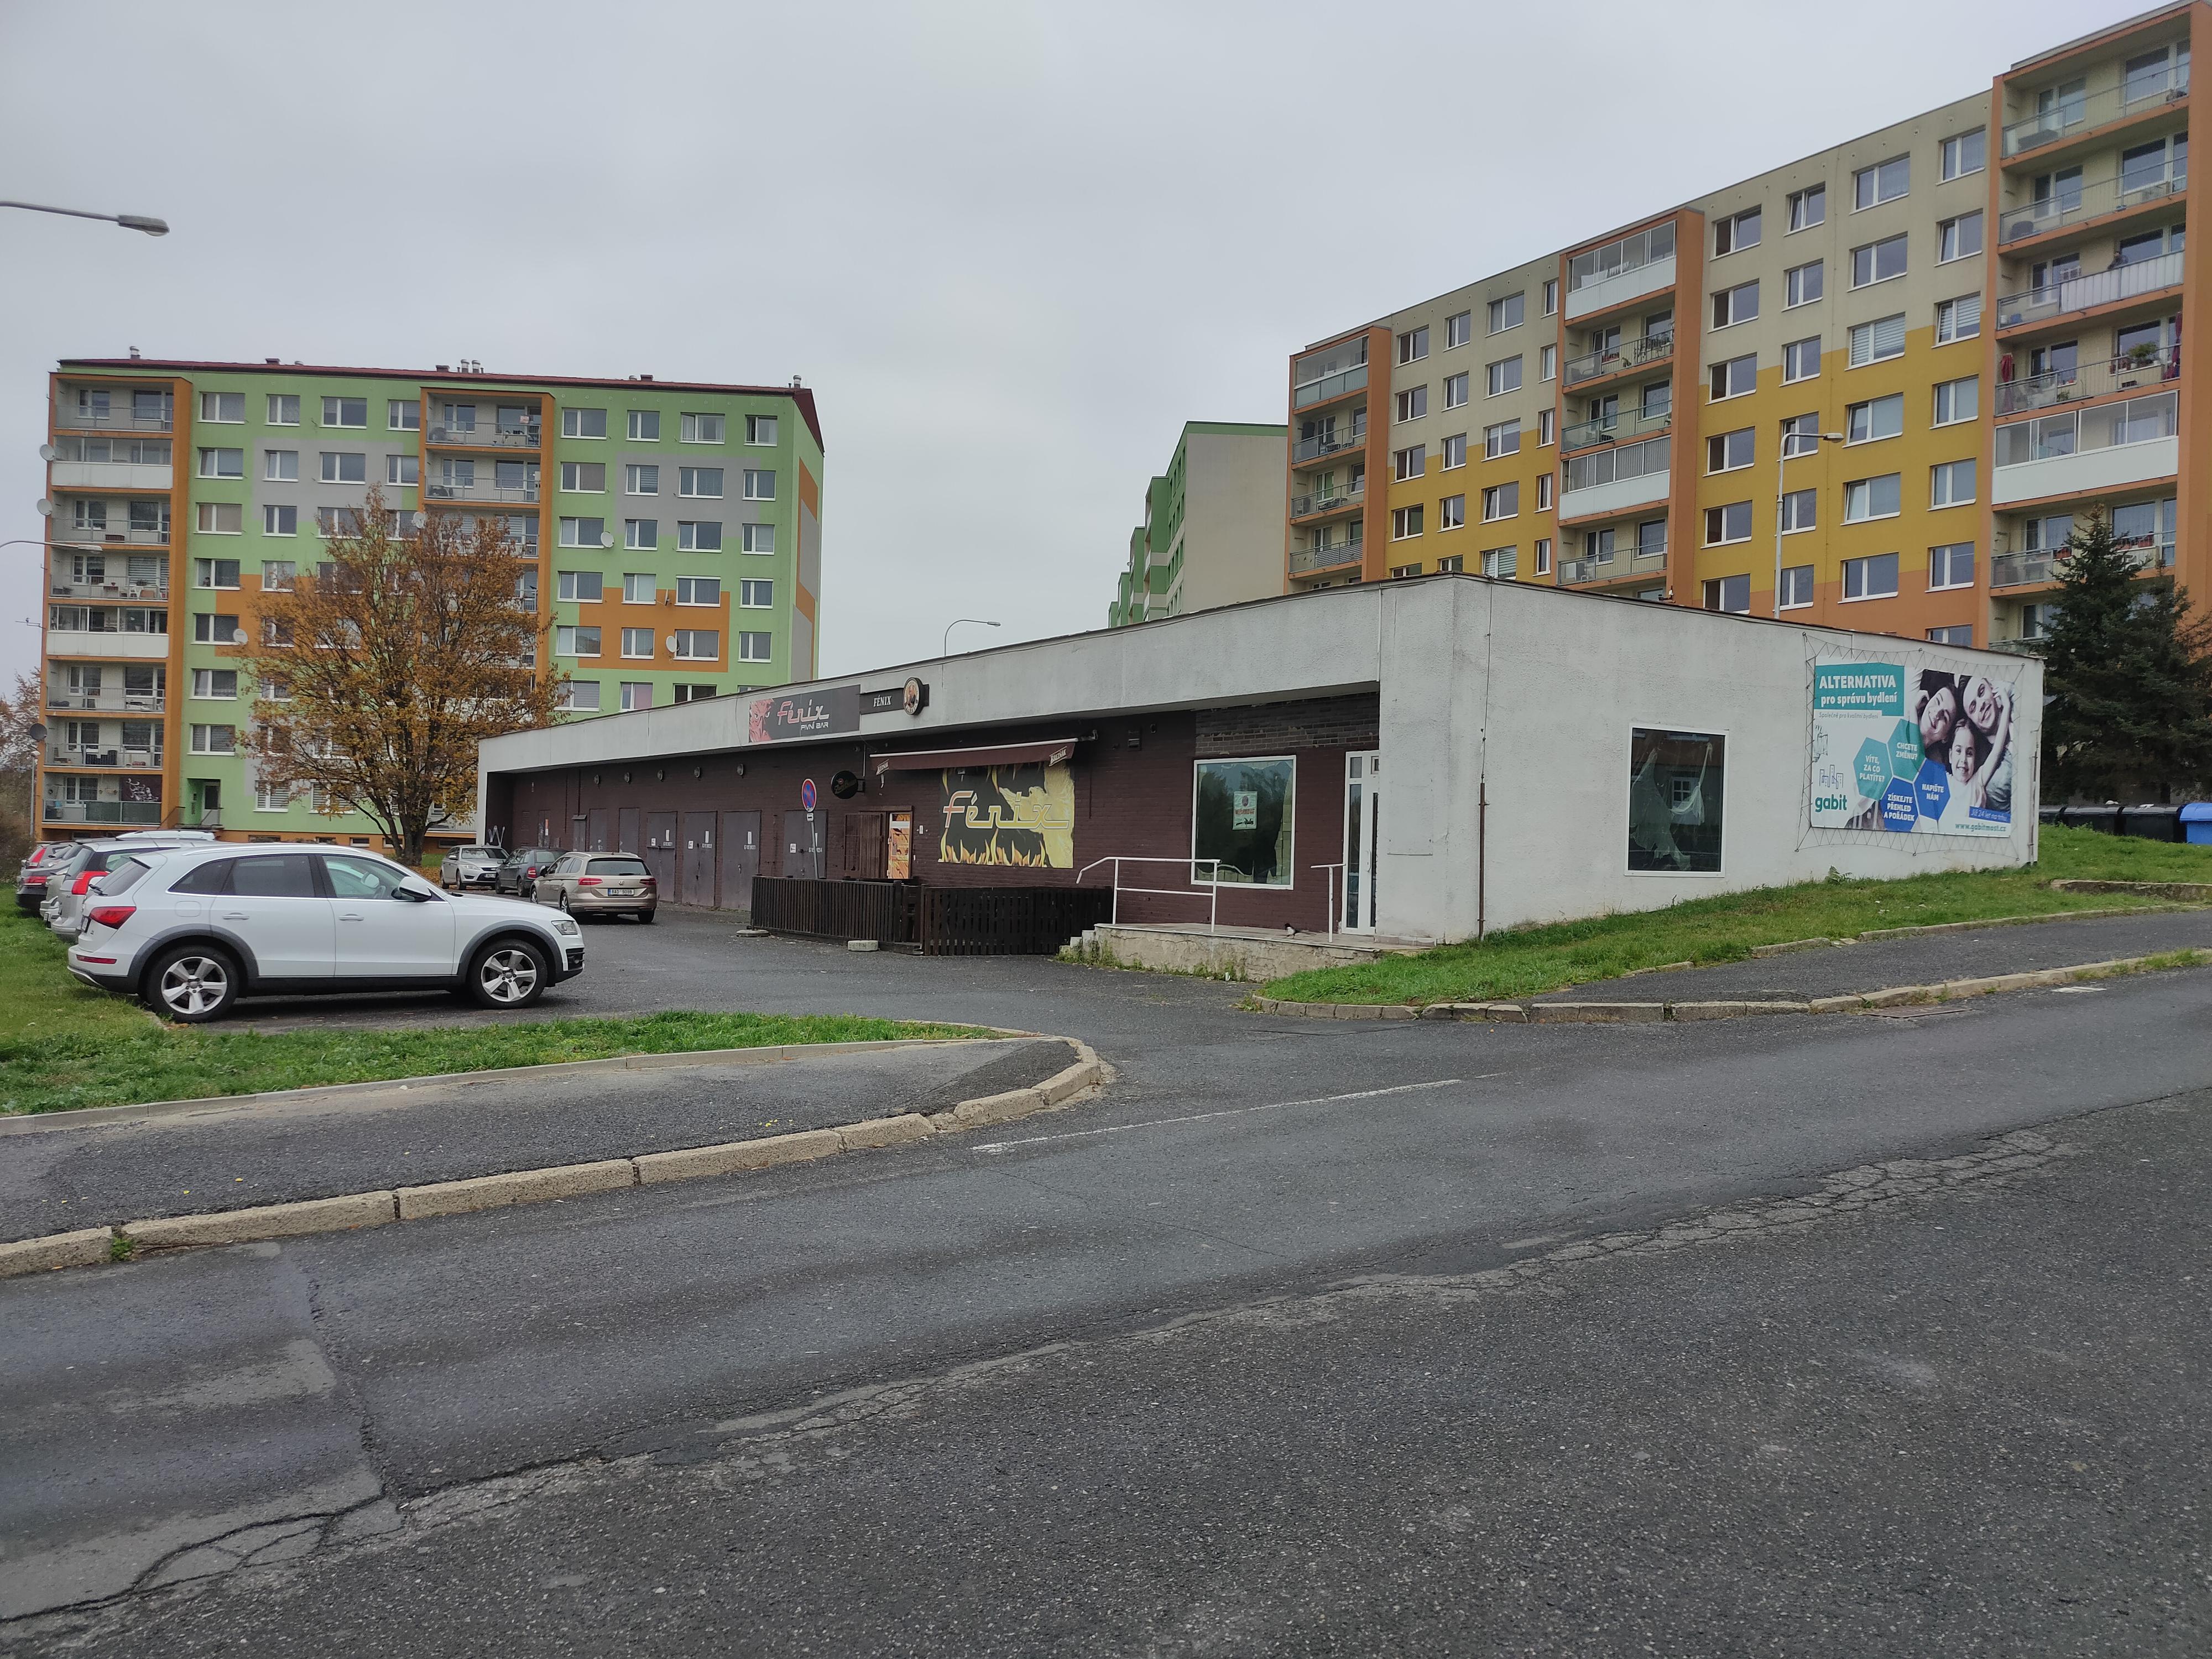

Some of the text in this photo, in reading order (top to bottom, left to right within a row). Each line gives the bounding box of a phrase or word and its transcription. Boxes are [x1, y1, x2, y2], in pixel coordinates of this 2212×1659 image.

[1819, 675, 1896, 689] ALTERNATIVA
[873, 695, 891, 707] FÉNIX
[1821, 692, 1897, 707] pro správu bydlení
[801, 722, 815, 731] PIVNÍ
[1897, 742, 1917, 751] CHCETE
[1865, 754, 1880, 764] VÍTE,
[1896, 750, 1918, 760] ZMĚNU?
[1859, 773, 1885, 782] PLATÍTE?
[1922, 783, 1944, 793] NAPIŠTE
[1887, 792, 1913, 804] ZÍSKEJTE
[1926, 792, 1939, 801] NÁM
[1815, 794, 1847, 812] gabit
[1887, 802, 1911, 812] PŘEHLED
[1888, 811, 1915, 821] POŘÁDEK
[1955, 822, 2006, 832] www.gabitmost.cz
